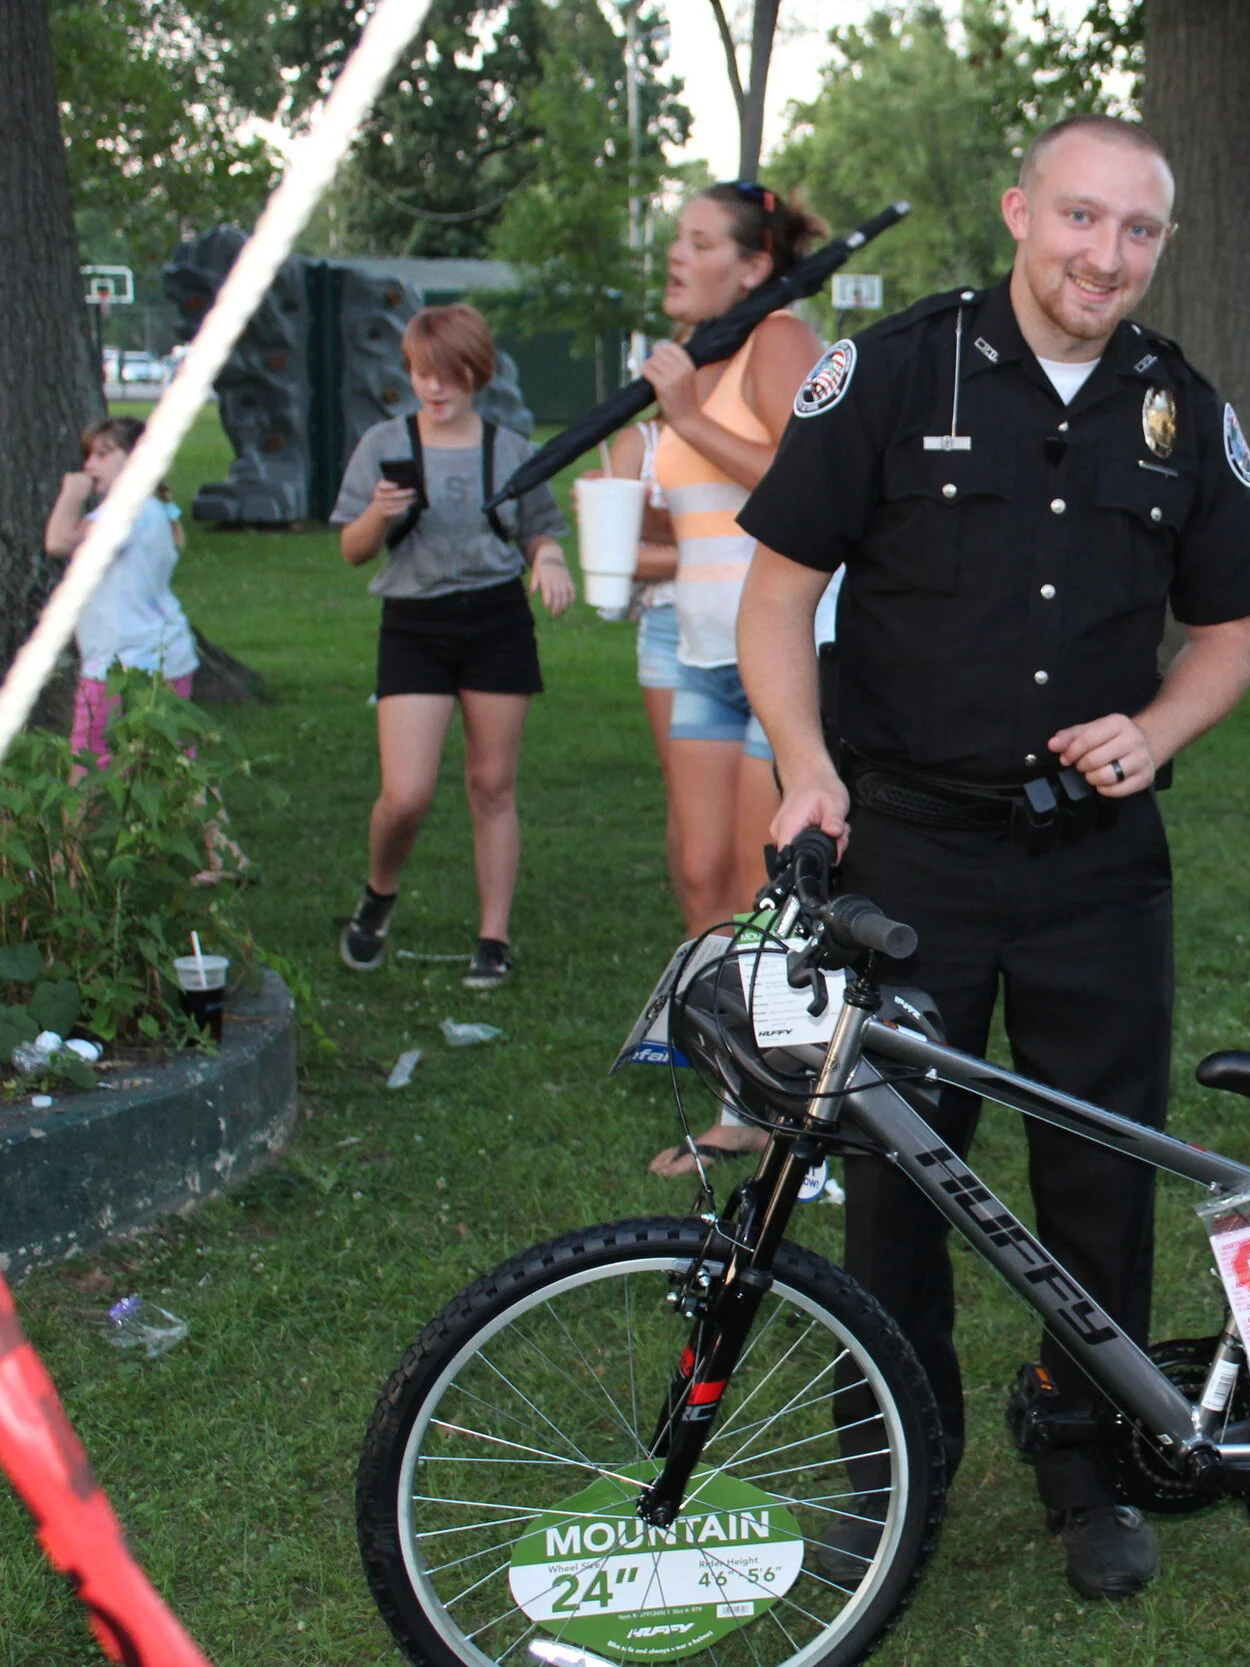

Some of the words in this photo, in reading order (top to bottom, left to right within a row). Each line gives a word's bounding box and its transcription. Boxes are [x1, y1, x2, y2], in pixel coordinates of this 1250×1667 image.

[914, 1147, 1118, 1345] HUFFY
[546, 1511, 769, 1556] MOUNTAIN
[548, 1563, 578, 1573] Wheel
[699, 1559, 723, 1567] Rider
[727, 1556, 759, 1566] Height
[552, 1566, 639, 1613] 24"
[627, 1623, 695, 1638] HUFFY
